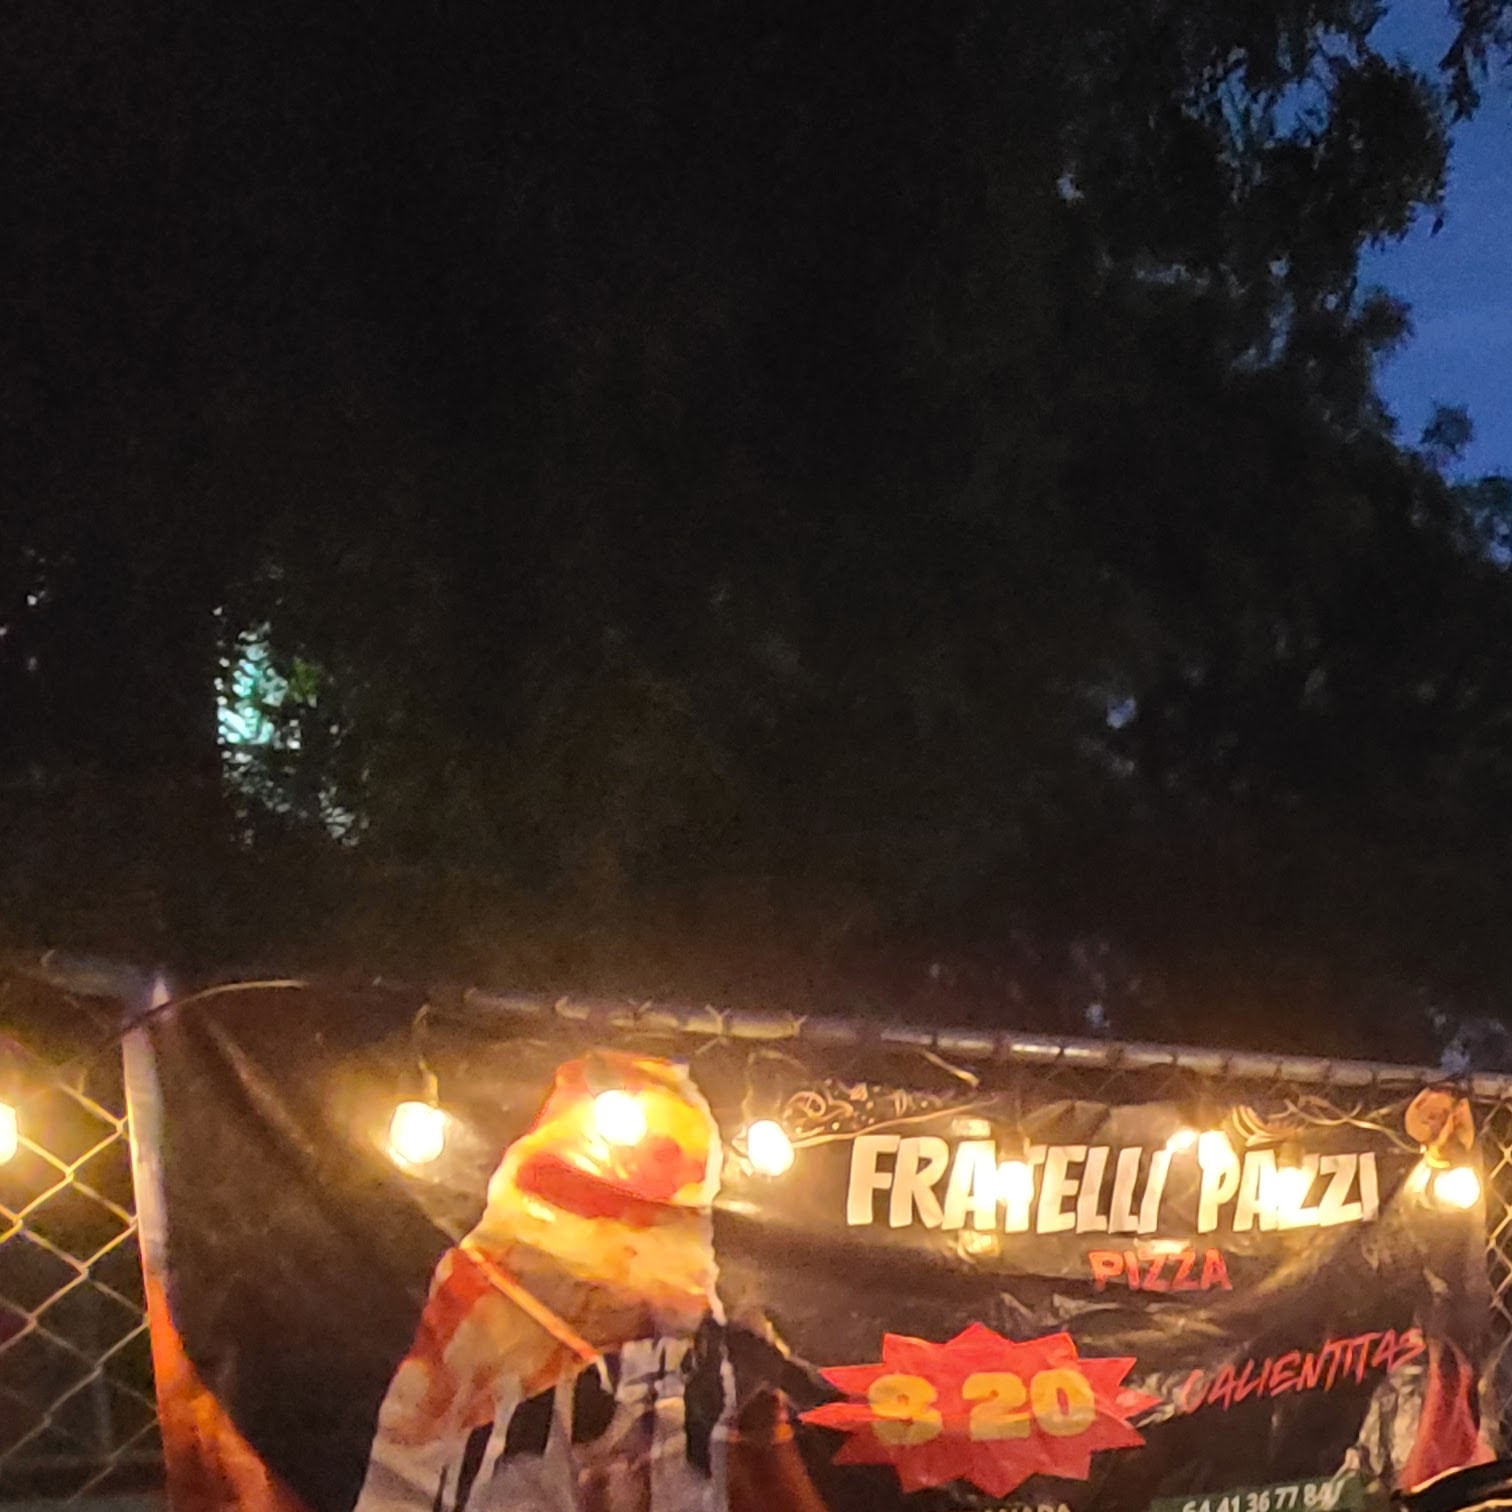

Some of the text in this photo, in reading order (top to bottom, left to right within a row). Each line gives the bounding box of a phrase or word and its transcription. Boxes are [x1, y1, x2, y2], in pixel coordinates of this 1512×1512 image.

[847, 1134, 1379, 1235] FRATELLI PAZZI
[1088, 1246, 1233, 1291] PIZZA
[1182, 1326, 1427, 1414] CALIENTITAS
[1274, 1486, 1299, 1509] 77
